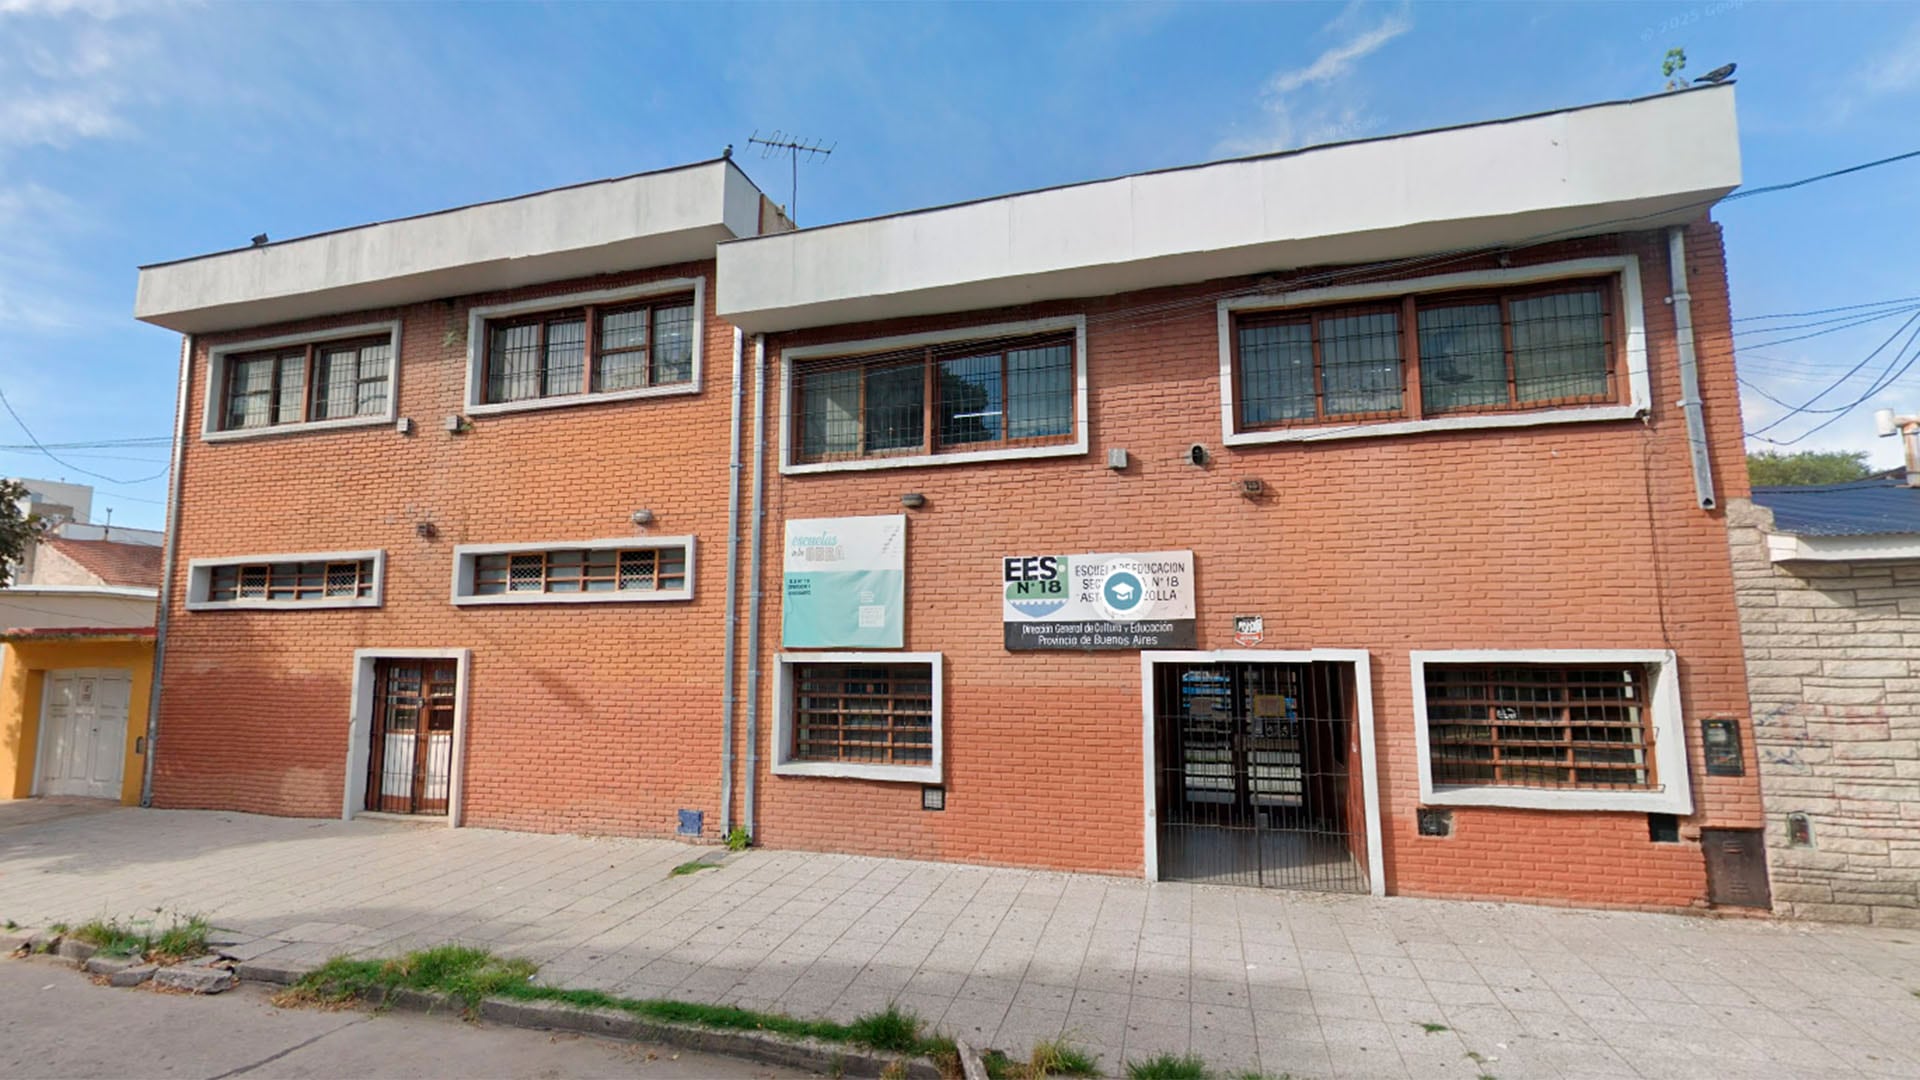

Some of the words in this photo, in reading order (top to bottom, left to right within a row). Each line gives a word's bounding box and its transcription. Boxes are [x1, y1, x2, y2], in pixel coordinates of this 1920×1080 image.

[791, 531, 837, 546] escuelas
[1005, 556, 1058, 582] EES
[1039, 580, 1062, 594] 18
[1166, 575, 1180, 587] 18
[1055, 622, 1083, 634] General
[1084, 622, 1094, 634] de
[1094, 622, 1122, 634] Cultura
[1038, 634, 1078, 646] Provincia
[1079, 635, 1092, 645] de
[1094, 634, 1130, 646] Buenos
[1132, 634, 1159, 645] Aires
